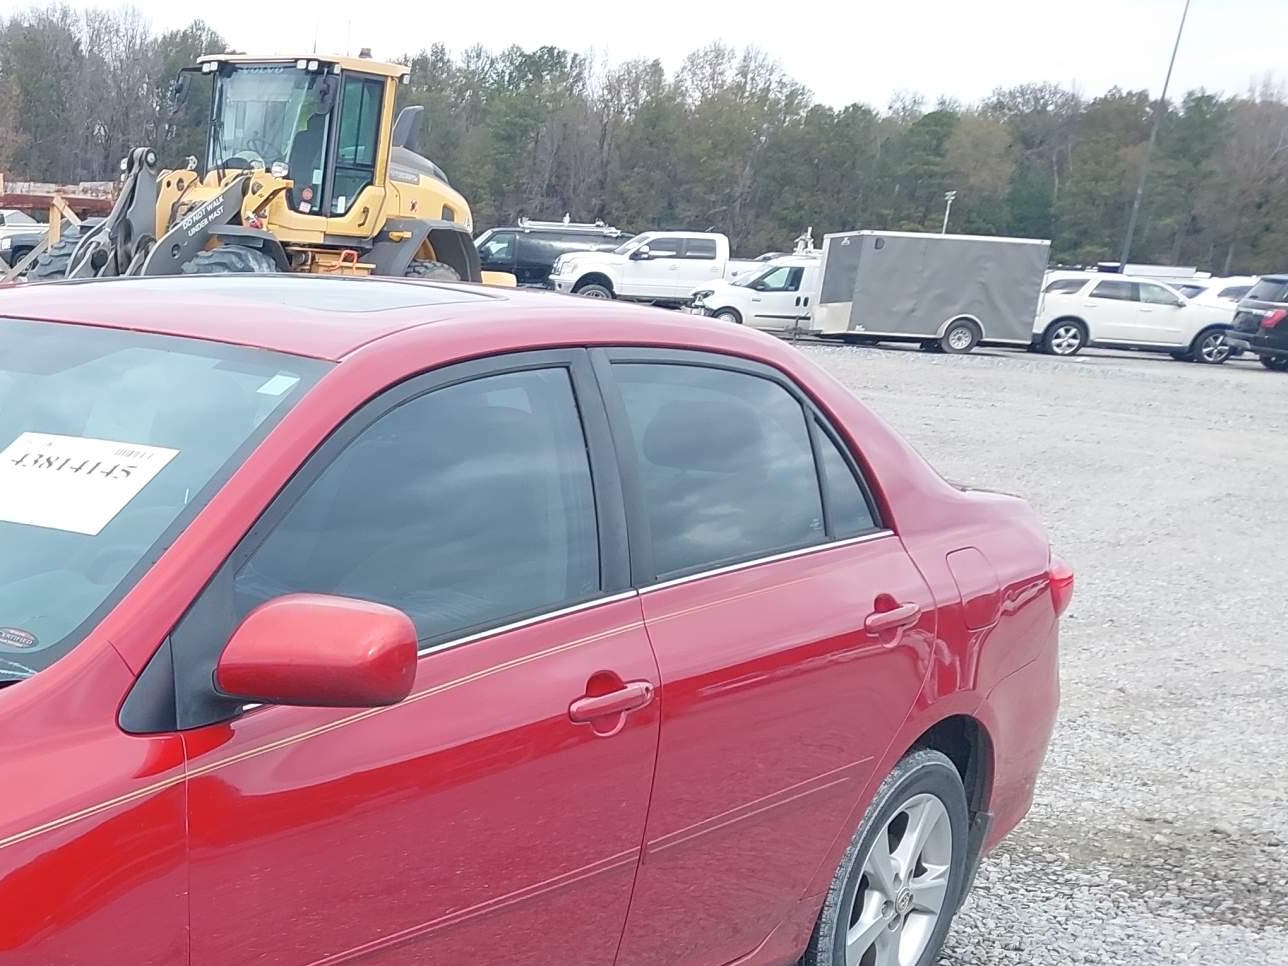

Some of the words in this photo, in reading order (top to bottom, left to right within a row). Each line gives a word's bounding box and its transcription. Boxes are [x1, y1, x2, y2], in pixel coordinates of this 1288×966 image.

[182, 218, 193, 230] DO
[192, 207, 206, 222] NOT
[206, 195, 225, 212] WALK
[188, 218, 209, 236] UNDER
[208, 205, 224, 222] MAST
[11, 453, 138, 479] 43814145
